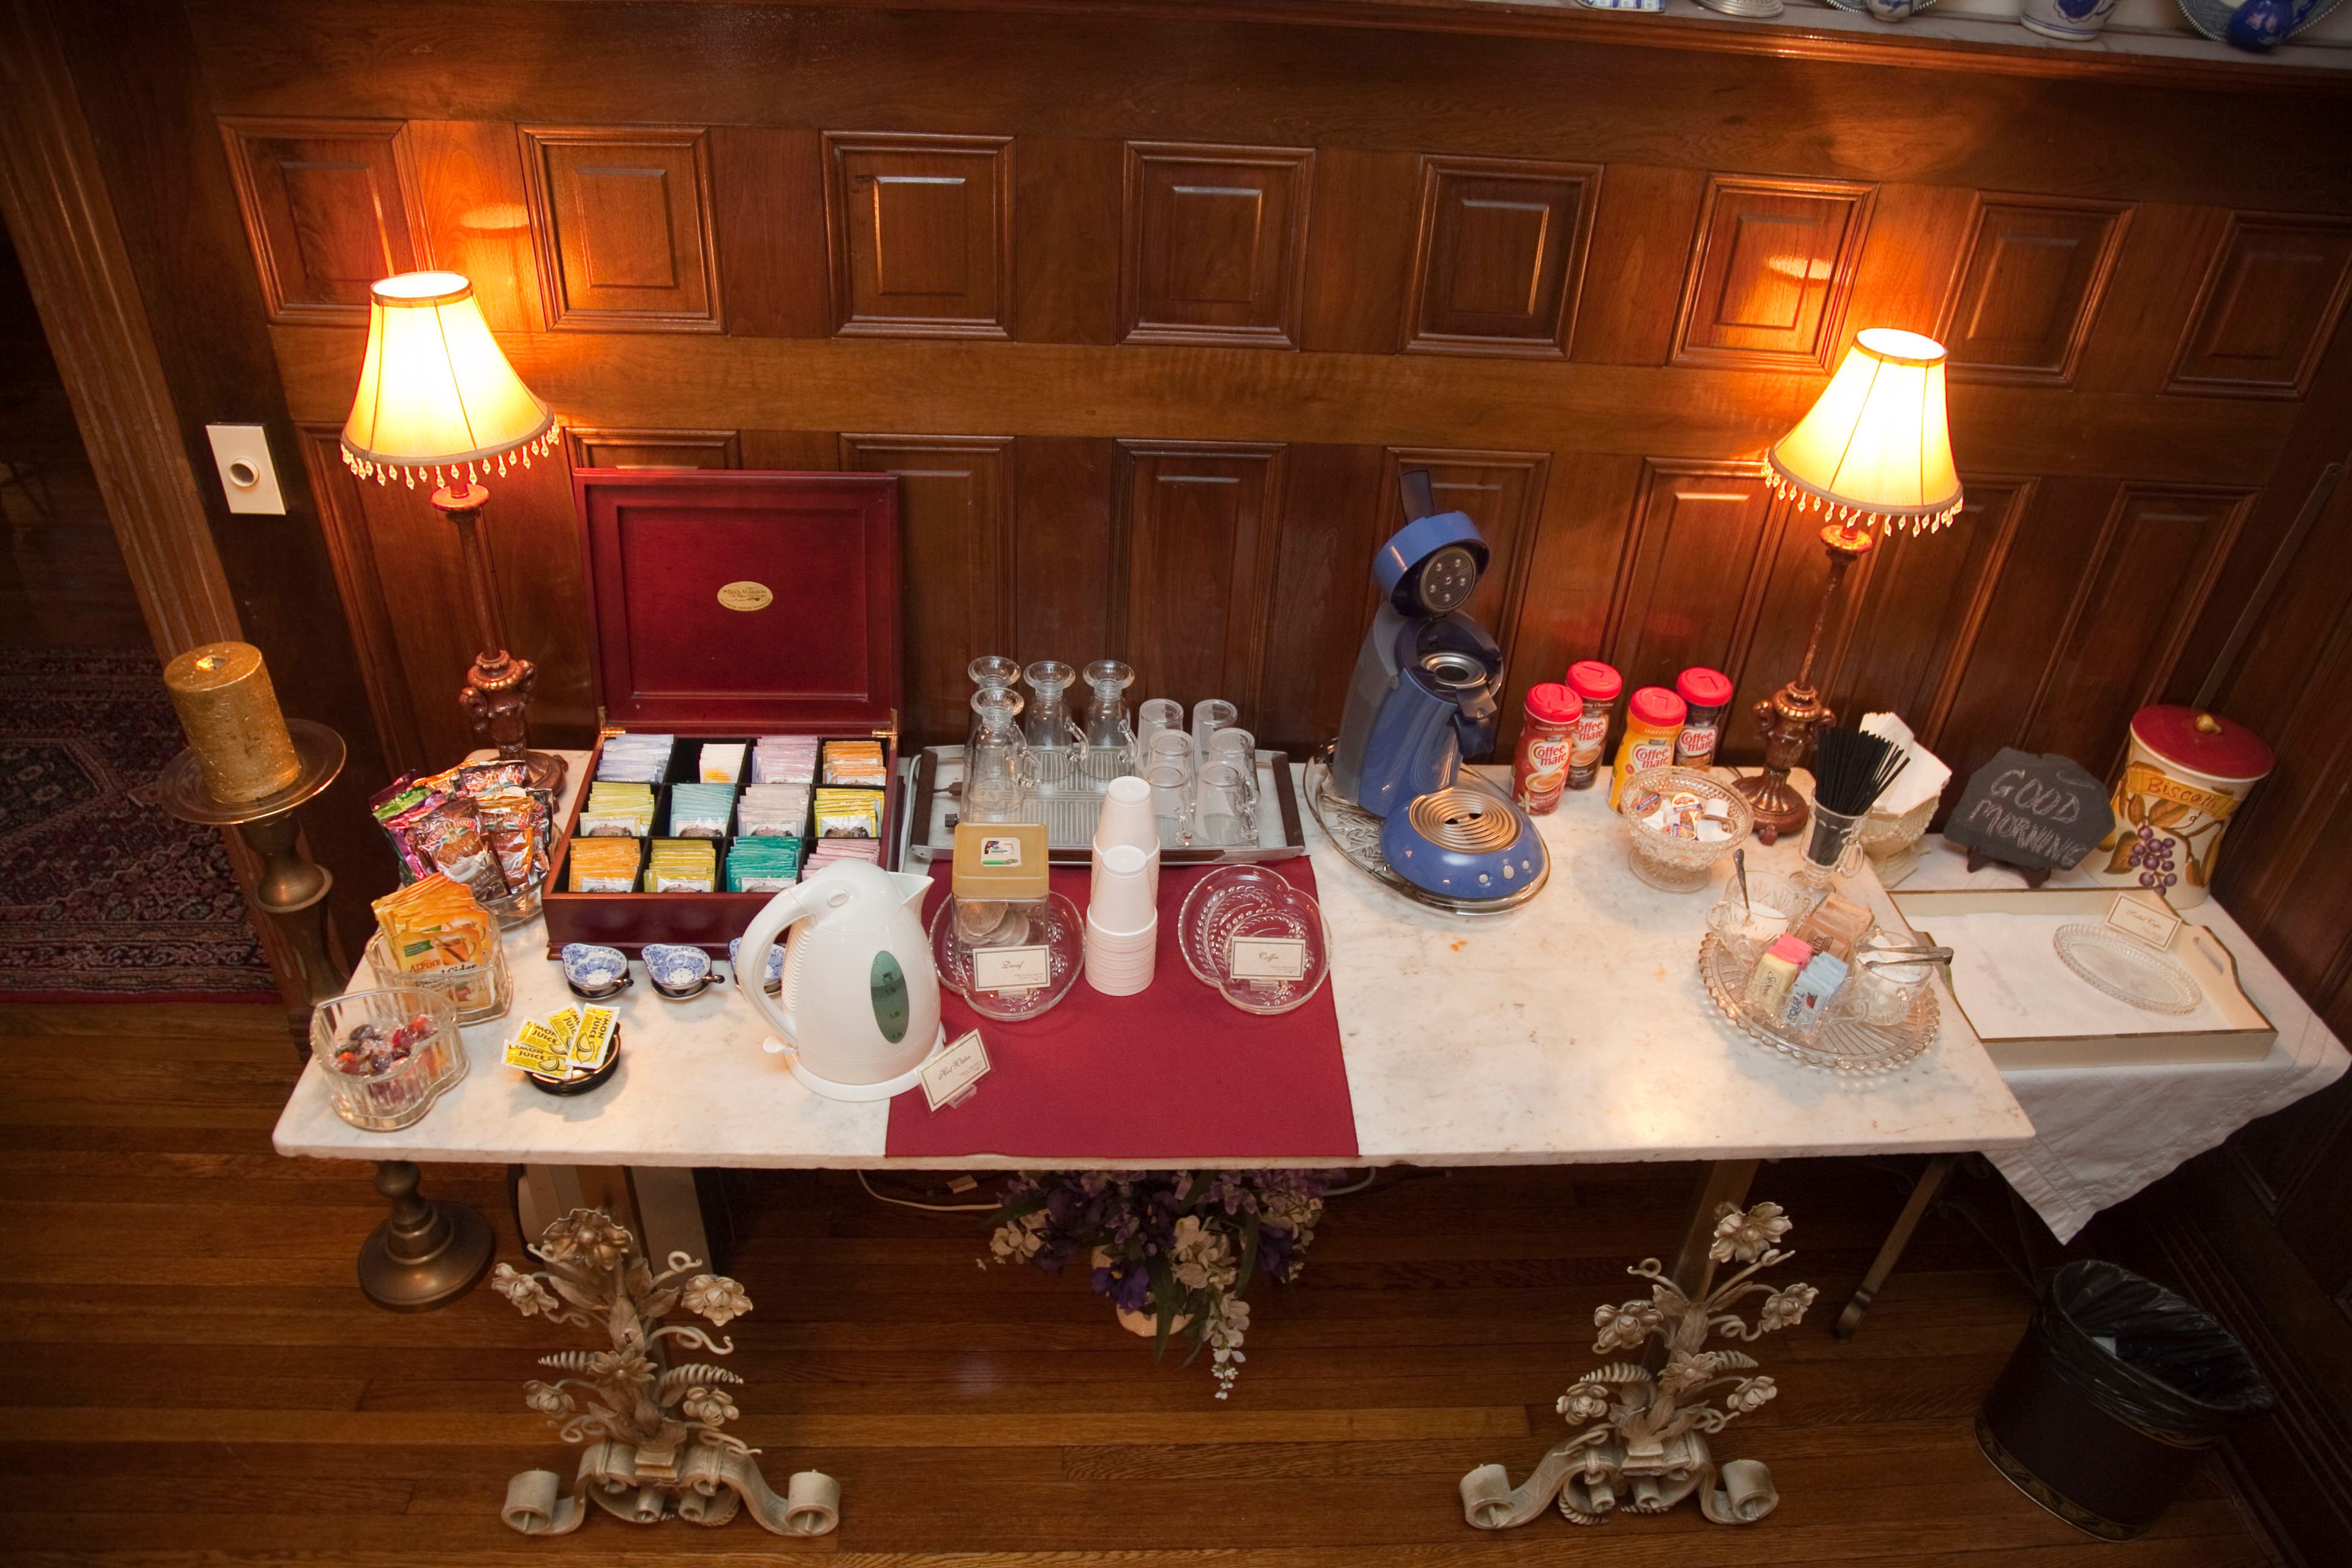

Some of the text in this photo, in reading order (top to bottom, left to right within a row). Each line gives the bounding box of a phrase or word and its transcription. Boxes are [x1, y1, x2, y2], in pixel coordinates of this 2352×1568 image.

[1576, 722, 1603, 734] offee
[1578, 729, 1604, 741] mate
[1681, 732, 1713, 745] Coffee
[1533, 745, 1566, 759] Coffee
[1687, 739, 1713, 752] mate
[1540, 753, 1566, 766] mate
[1635, 748, 1668, 761] Coffee
[1642, 756, 1668, 768] mate
[1990, 767, 2081, 824] GOOD
[2147, 777, 2218, 809] Biscotti
[1968, 798, 2088, 868] MORNING
[1258, 951, 1279, 962] Coffee
[410, 959, 441, 973] ALPINE
[1001, 960, 1025, 970] Decaf
[564, 1017, 576, 1035] JUIC
[589, 1017, 602, 1039] JUICE
[532, 1030, 557, 1044] JUICE
[519, 1050, 545, 1060] JUICE
